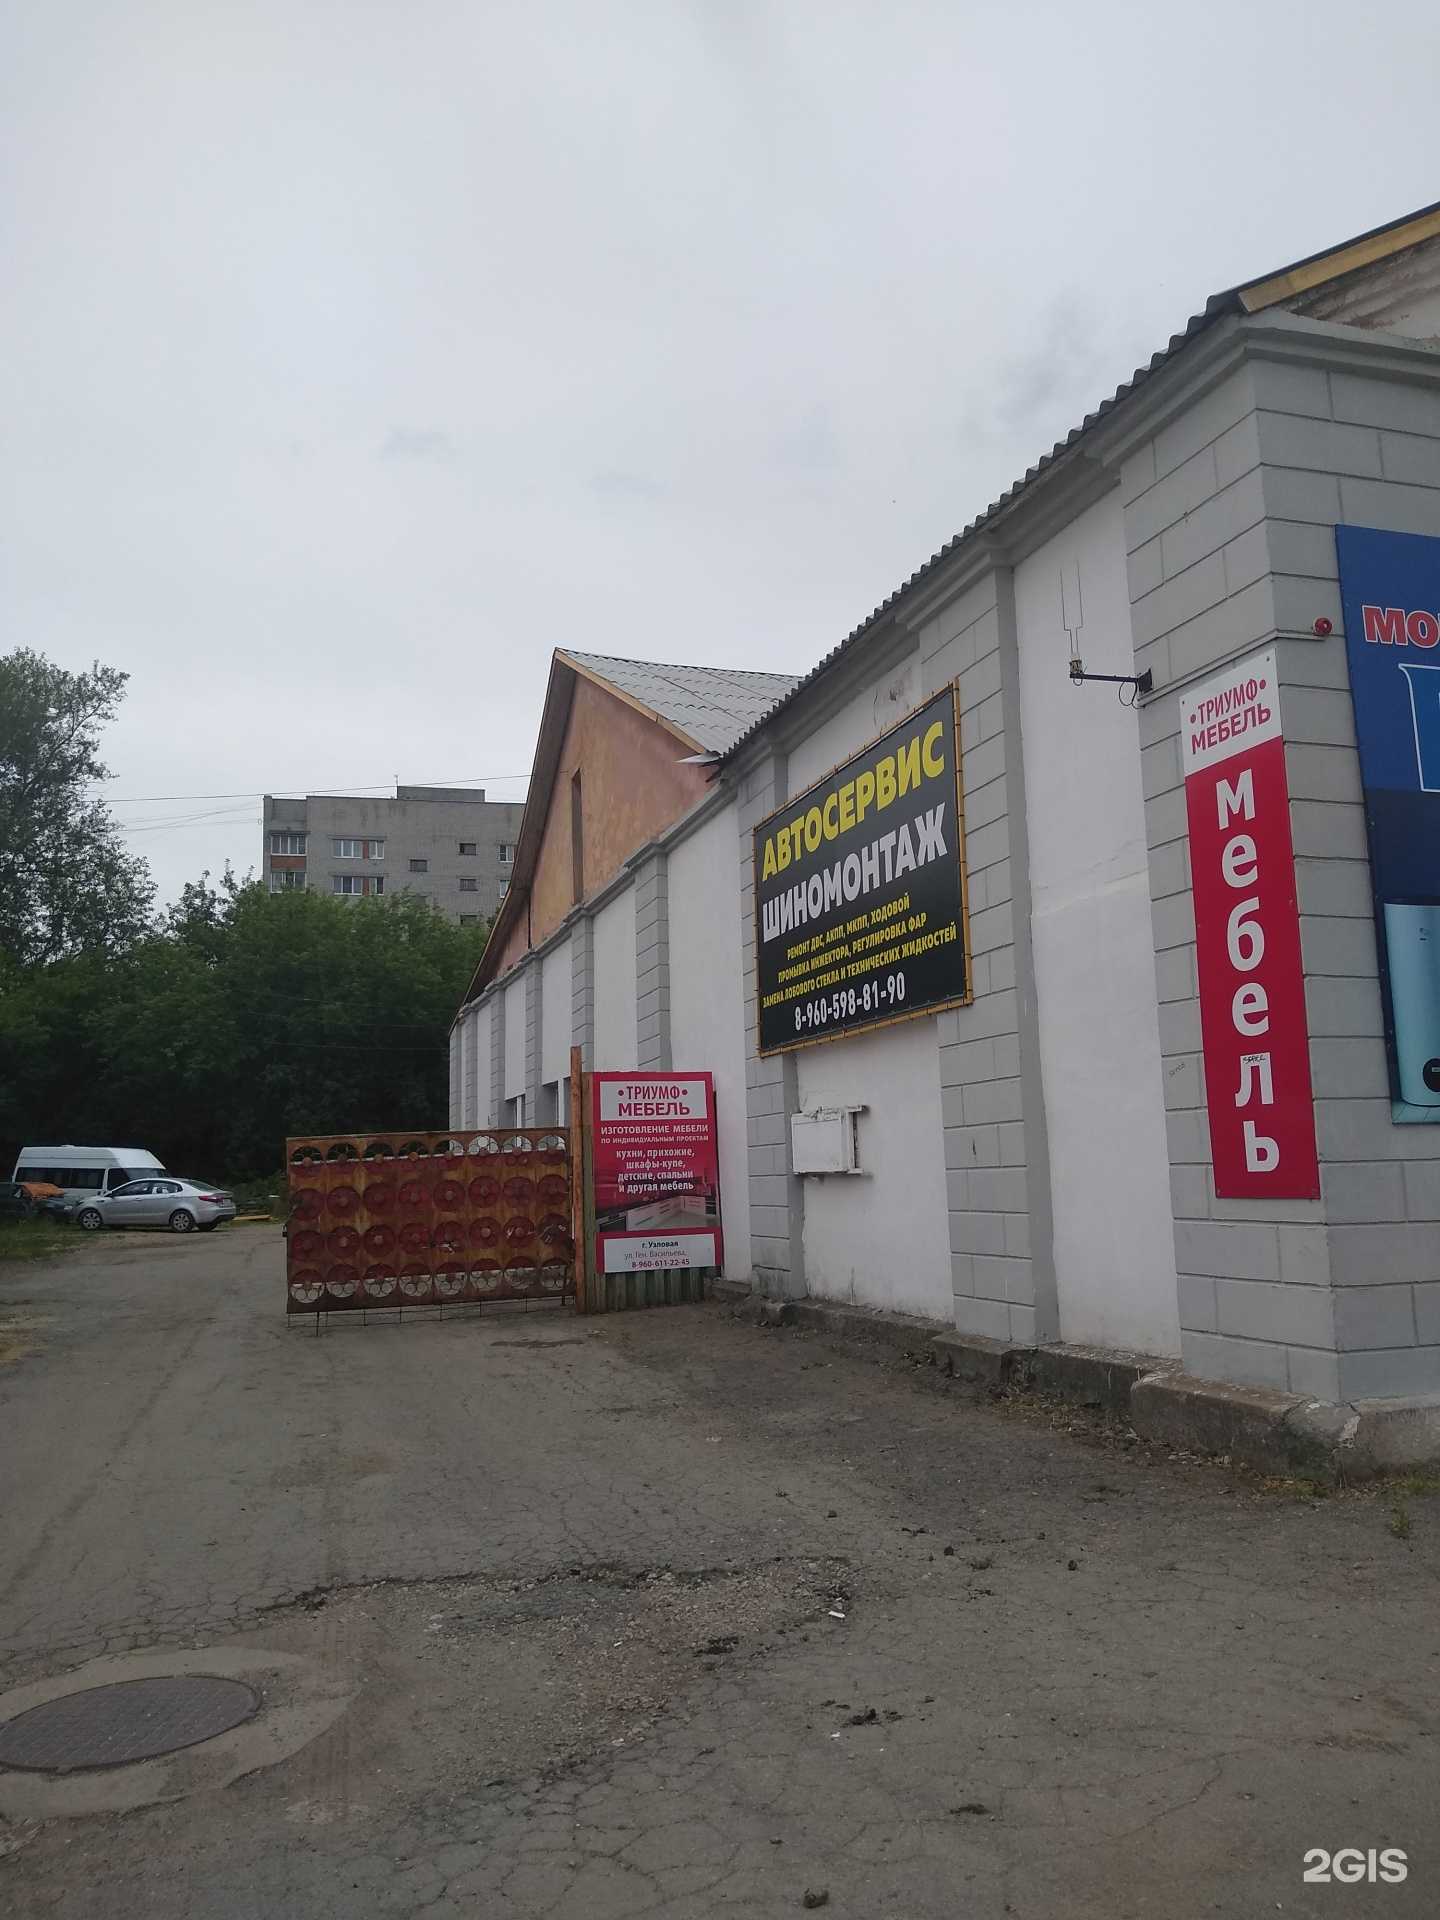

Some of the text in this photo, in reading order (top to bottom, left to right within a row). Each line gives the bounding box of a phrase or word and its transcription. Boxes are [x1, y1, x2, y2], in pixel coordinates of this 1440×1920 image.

[1362, 605, 1440, 649] МО
[1191, 702, 1271, 755] МЕБЕЛЬ
[762, 721, 945, 882] АВТОСЕРВИС
[763, 802, 948, 944] ШИНОМОНТАЖ
[787, 892, 910, 960] РЕМОНТ ДВС, АКПП, МКПП, ХОДОВОЙ
[778, 912, 927, 983] ПРОМЫВКА ИНЖЕКТОРА, РЕГУЛИРОВКА ФАР
[763, 921, 957, 1008] ЗАМЕНА ЛОБОВОГО СТЕКЛА И ТЕХНИЧЕСКИХ ЖИДКОСТЕЙ
[795, 972, 906, 1031] 8-960-598-81-90
[618, 1102, 690, 1116] МЕБЕЛЬ
[601, 1125, 709, 1135] ИЗГОТОВЛЕНИЕ МЕБЕЛИ
[612, 1136, 675, 1144] ИНДИВИДУАЛЬНЫМ
[616, 1147, 695, 1161] кухни, прихожие,
[626, 1159, 686, 1171] шкафы-купе,
[618, 1170, 694, 1183] детские, спальни
[619, 1180, 694, 1194] и другая мебель
[648, 1240, 679, 1249] Узловая
[631, 1258, 690, 1268] 8-960-611-22-45
